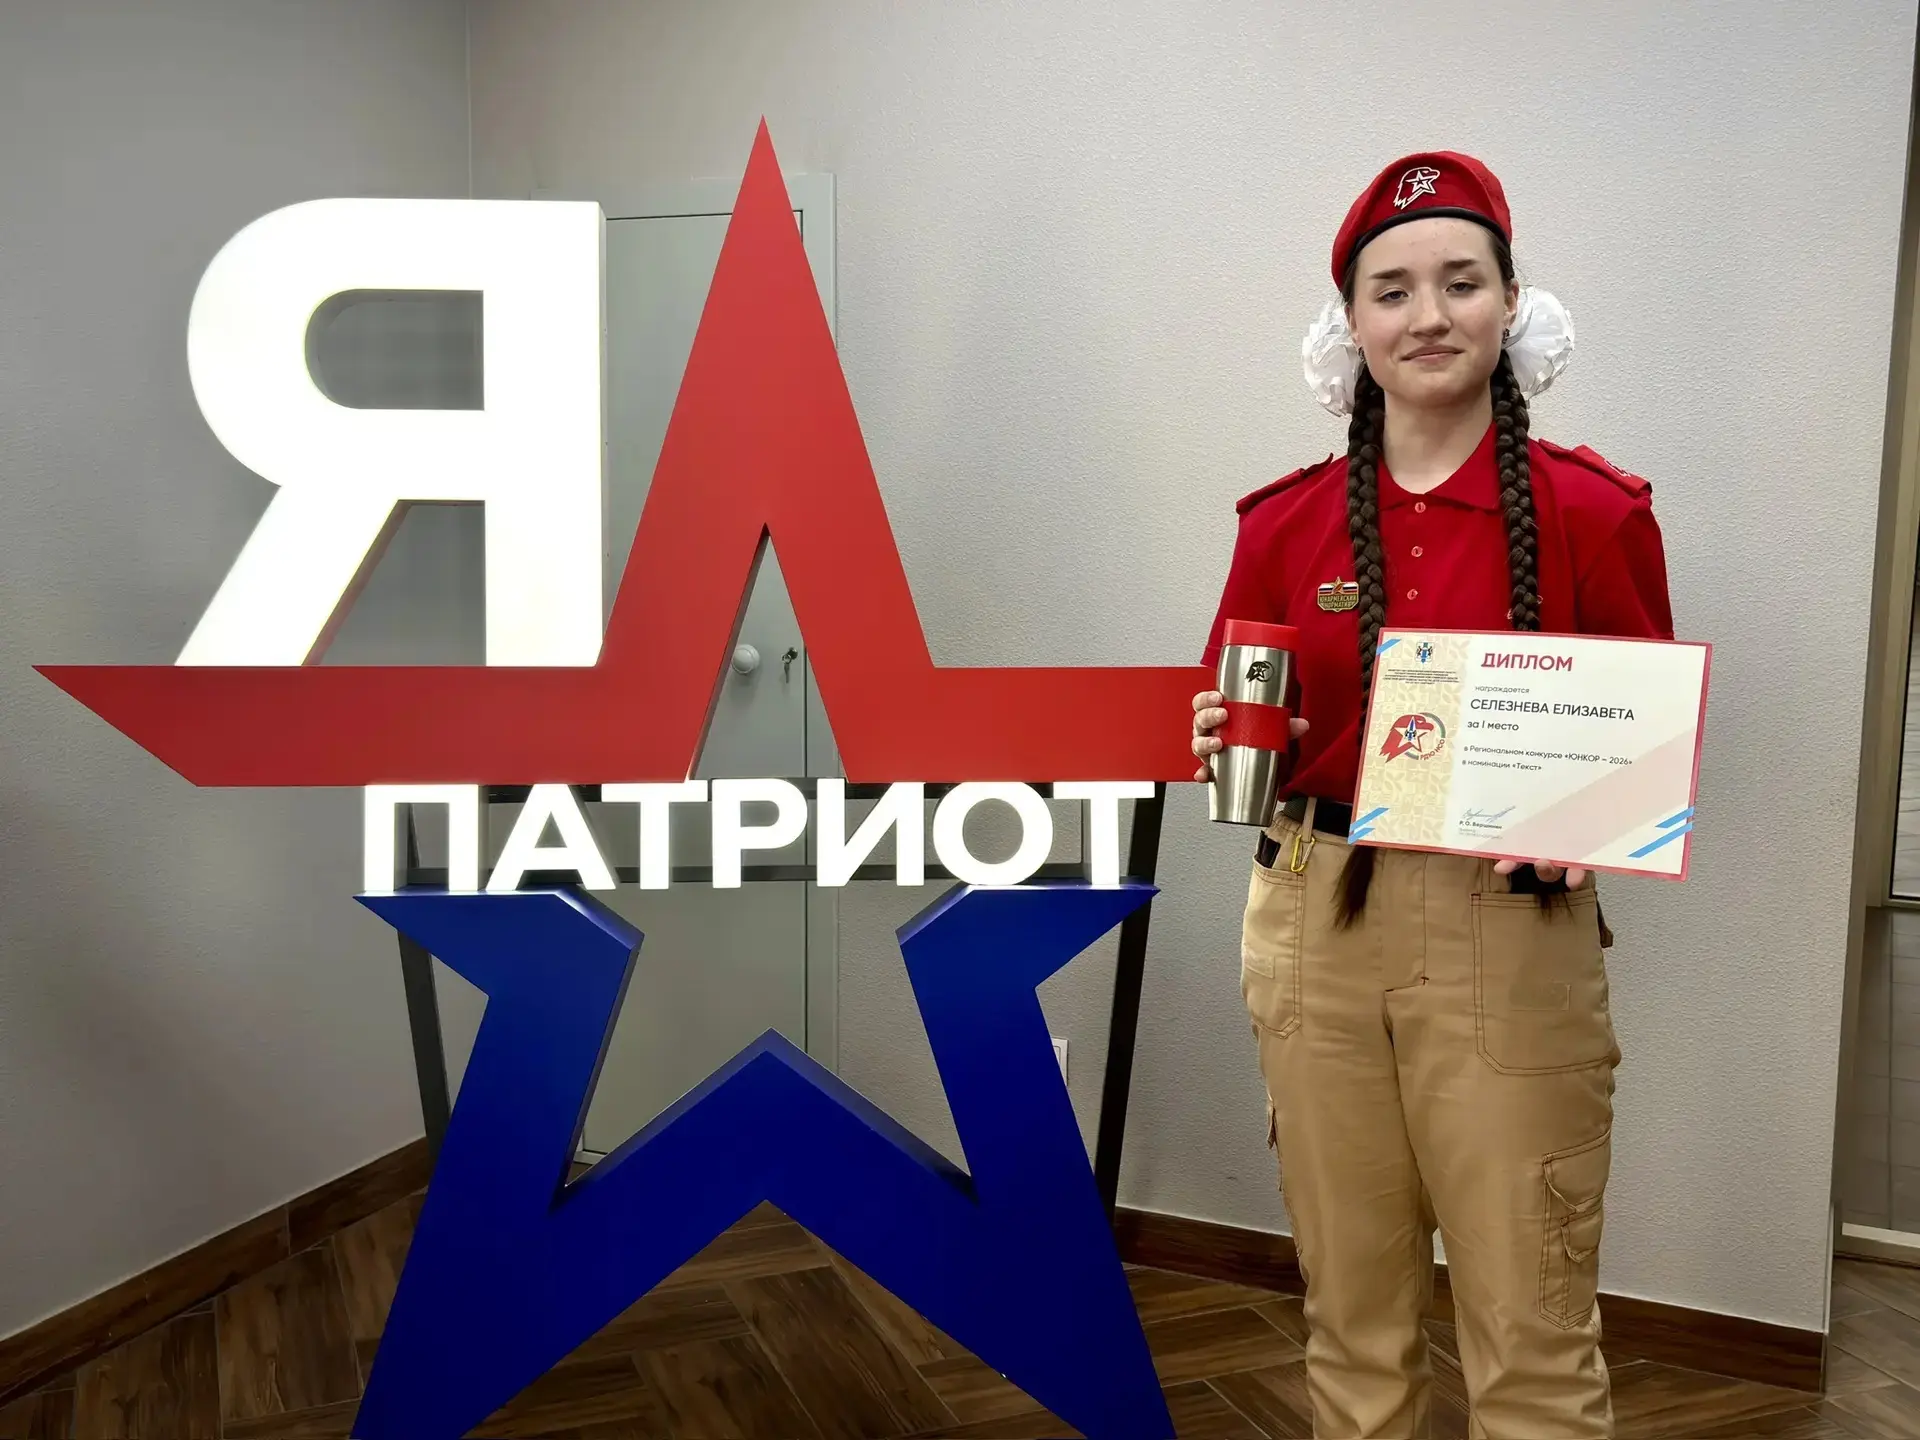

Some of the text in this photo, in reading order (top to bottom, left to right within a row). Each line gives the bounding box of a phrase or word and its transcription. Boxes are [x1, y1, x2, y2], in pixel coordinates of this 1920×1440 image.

[174, 198, 604, 667] Я
[1481, 653, 1573, 671] ДИПЛОМ
[1475, 686, 1530, 694] награждается
[1470, 699, 1634, 720] СЕЛЕЗНЕВА ЕЛИЗАВЕТА
[1467, 721, 1479, 729] за
[1487, 722, 1519, 731] место
[1469, 745, 1524, 756] Региональном
[1525, 751, 1563, 759] конкурсе
[1564, 753, 1600, 762] «ЮНКОР
[1467, 760, 1510, 768] номинации
[1512, 762, 1542, 771] «Текст»
[363, 779, 1156, 891] ПАТРИОТ
